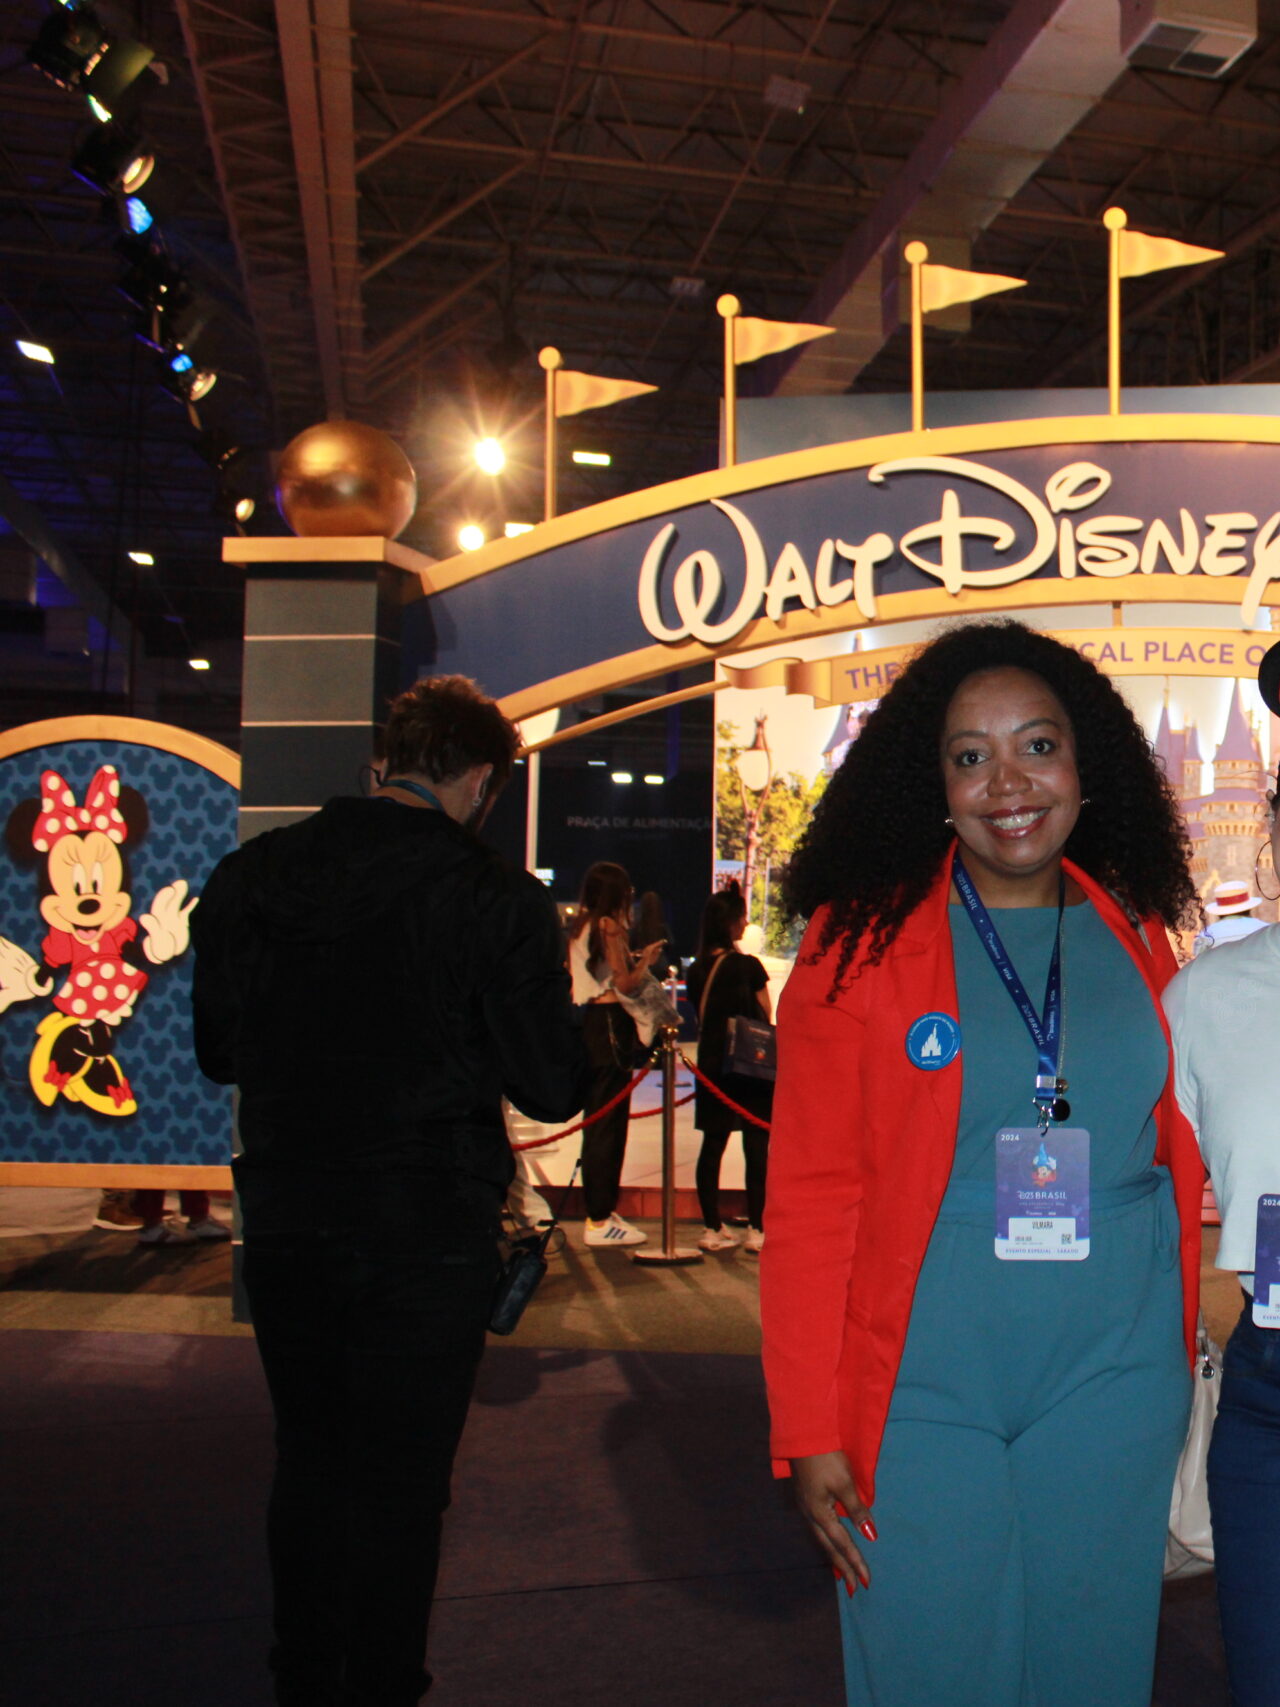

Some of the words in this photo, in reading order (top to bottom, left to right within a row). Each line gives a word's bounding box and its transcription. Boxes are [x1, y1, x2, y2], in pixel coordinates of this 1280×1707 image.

[1143, 641, 1234, 664] PLACE
[566, 815, 609, 829] PRAÇA
[613, 816, 629, 828] DE
[1035, 1191, 1067, 1200] BRASIL
[1263, 1198, 1280, 1206] 2024
